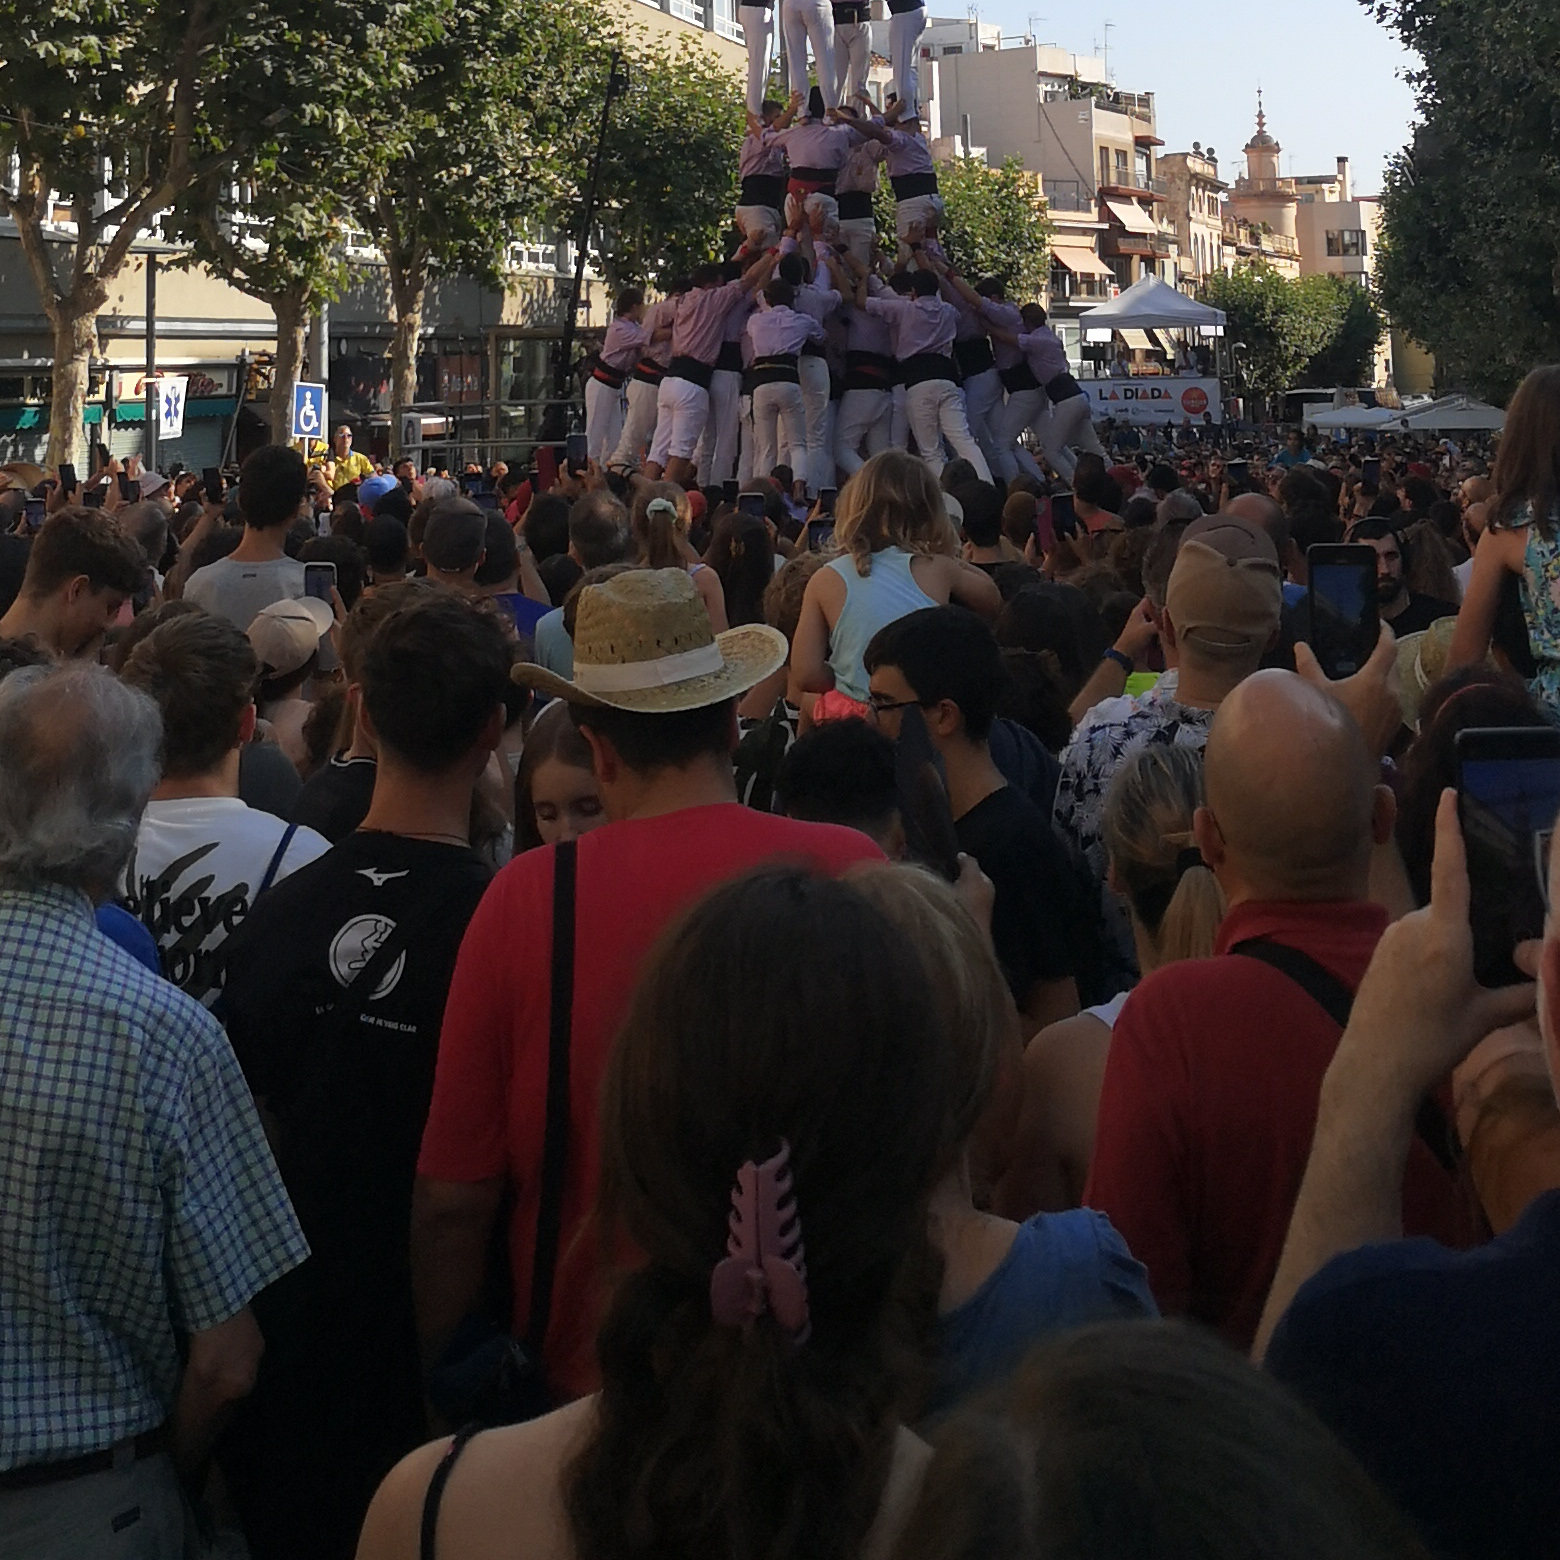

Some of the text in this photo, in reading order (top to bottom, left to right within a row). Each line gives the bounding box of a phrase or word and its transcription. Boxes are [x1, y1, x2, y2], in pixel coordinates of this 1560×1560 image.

[1099, 388, 1172, 400] LA DIADA
[124, 873, 250, 934] elieve
